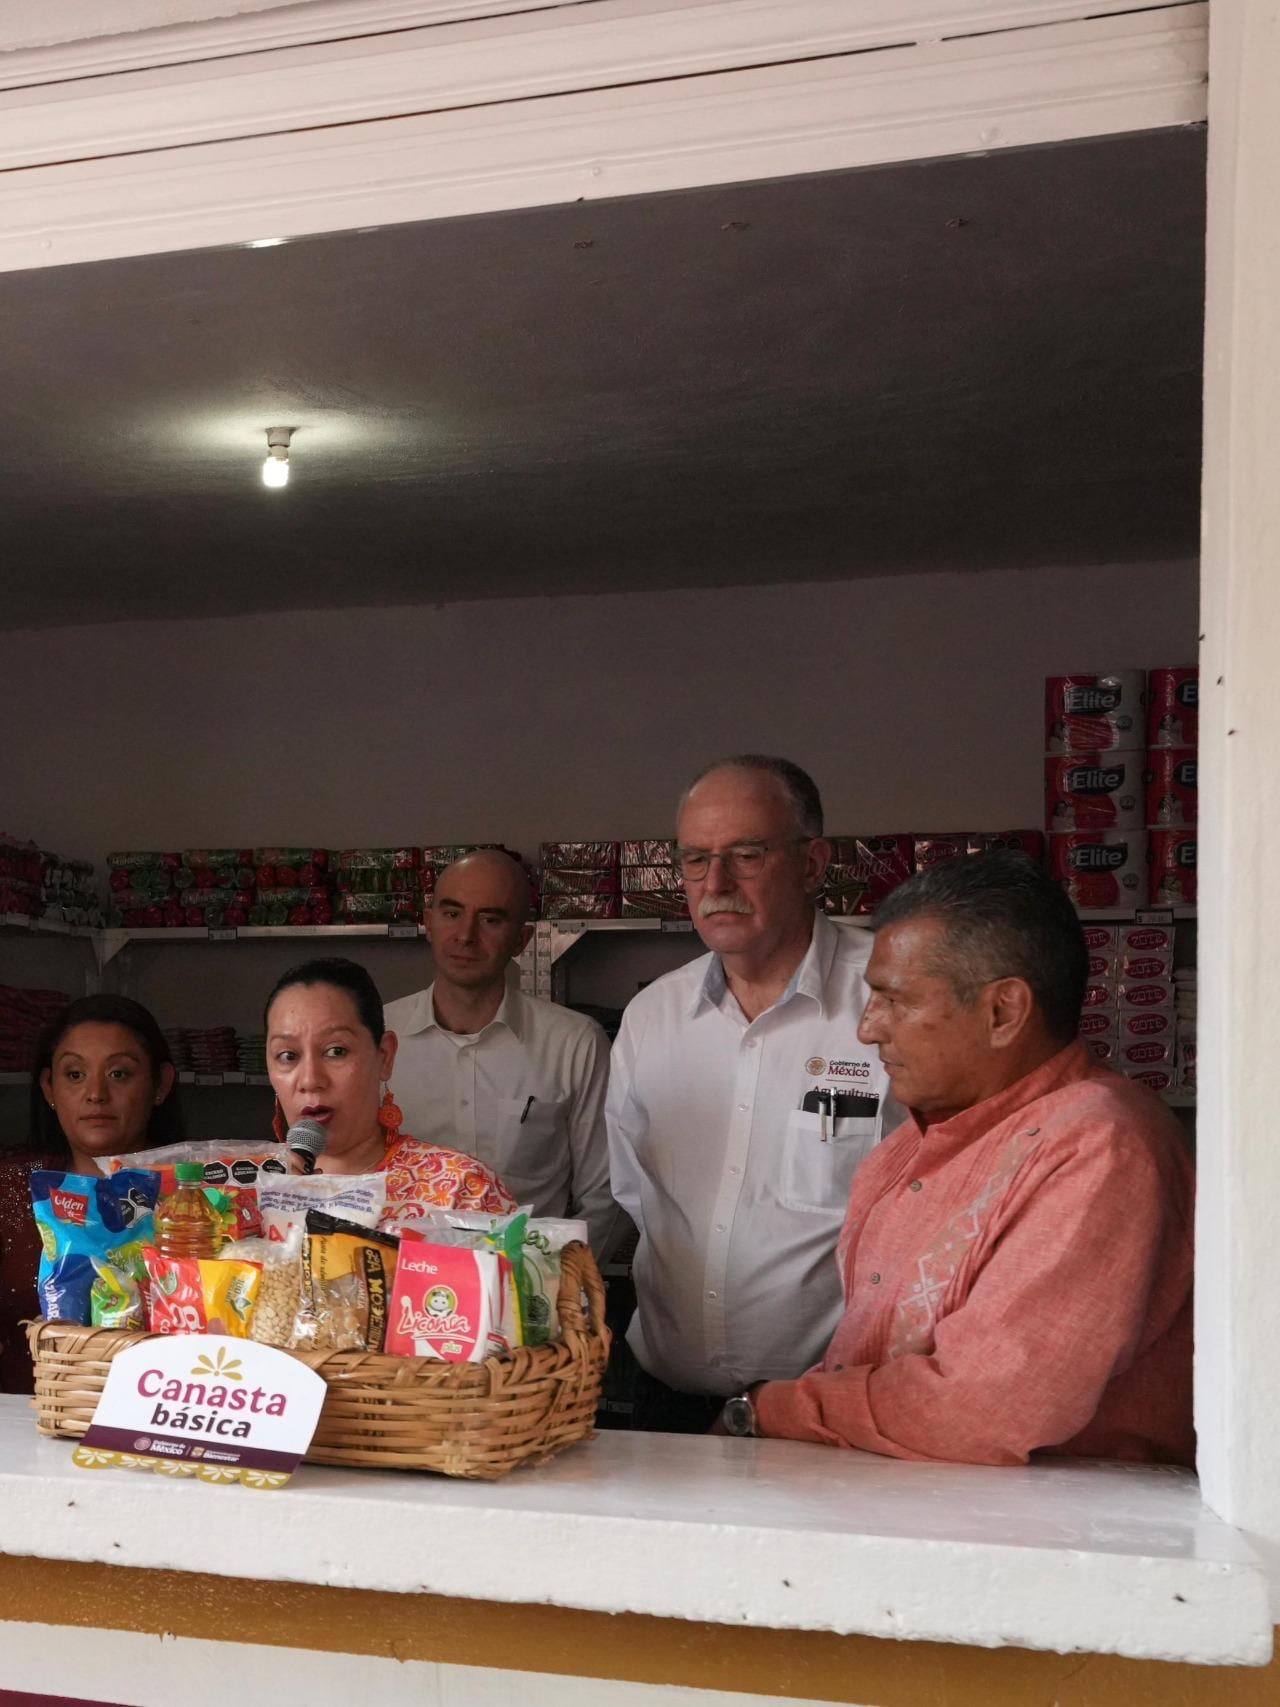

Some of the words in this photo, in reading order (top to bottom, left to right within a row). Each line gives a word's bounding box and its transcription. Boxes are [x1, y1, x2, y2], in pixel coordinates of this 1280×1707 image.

[1070, 691, 1116, 710] Elite
[1072, 769, 1120, 789] Elite
[1075, 848, 1122, 867] Elite
[1131, 933, 1163, 945] ZOTE
[827, 1065, 870, 1078] México
[401, 1258, 438, 1275] Leche
[397, 1295, 471, 1335] Liconsa
[137, 1369, 288, 1418] Canasta
[150, 1402, 252, 1439] básica
[149, 1444, 184, 1456] México
